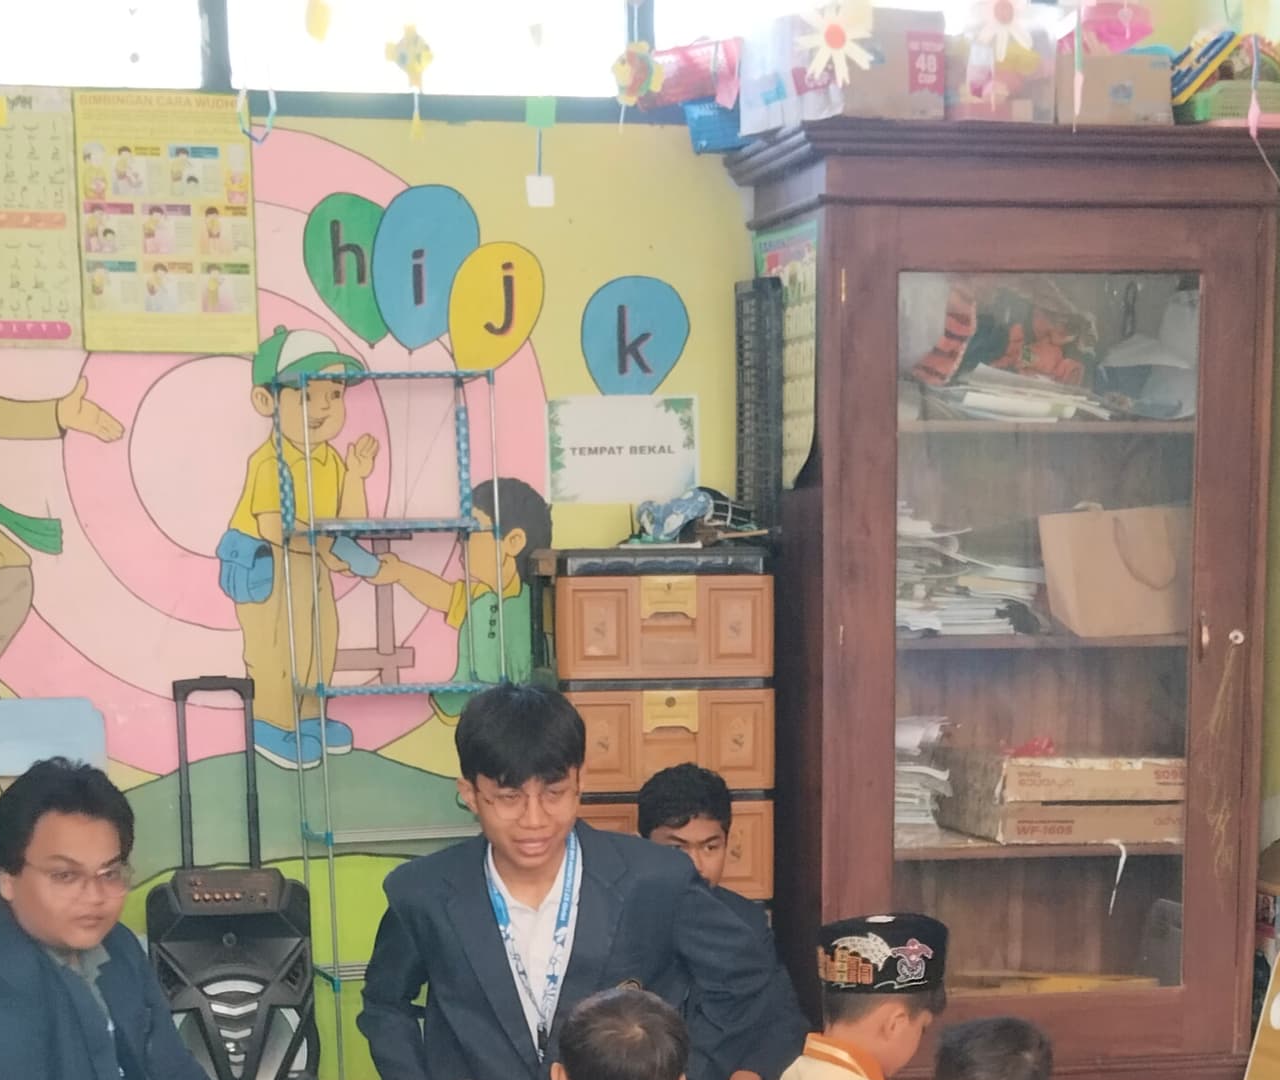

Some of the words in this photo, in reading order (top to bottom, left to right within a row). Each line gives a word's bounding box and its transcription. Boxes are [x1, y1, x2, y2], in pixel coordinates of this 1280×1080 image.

[79, 94, 153, 106] BIMBINGAN
[156, 96, 192, 106] CARA
[194, 97, 238, 109] WUDH
[329, 219, 366, 286] h
[412, 248, 425, 306] i
[483, 261, 516, 337] j
[616, 305, 653, 375] k
[569, 446, 625, 457] TEMPAT
[629, 444, 676, 456] BEKAL
